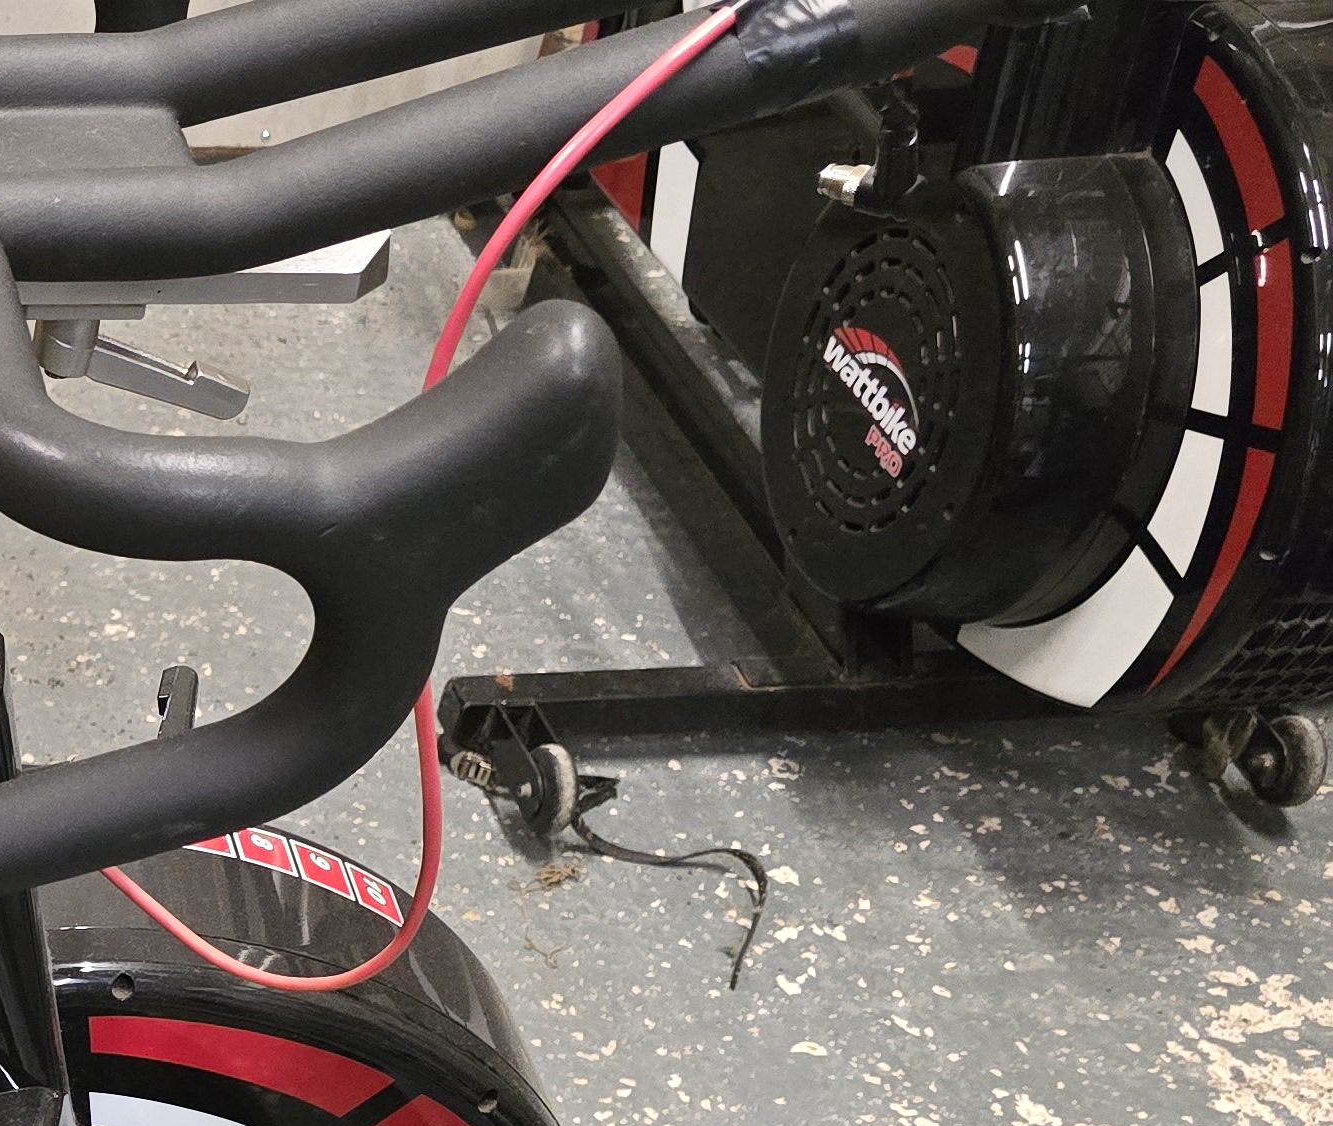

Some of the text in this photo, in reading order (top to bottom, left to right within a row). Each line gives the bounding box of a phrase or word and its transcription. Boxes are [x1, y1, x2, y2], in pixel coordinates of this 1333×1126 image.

[823, 335, 917, 455] wattbike
[865, 424, 903, 478] PRO
[250, 833, 274, 851] 8
[362, 877, 387, 906] 10
